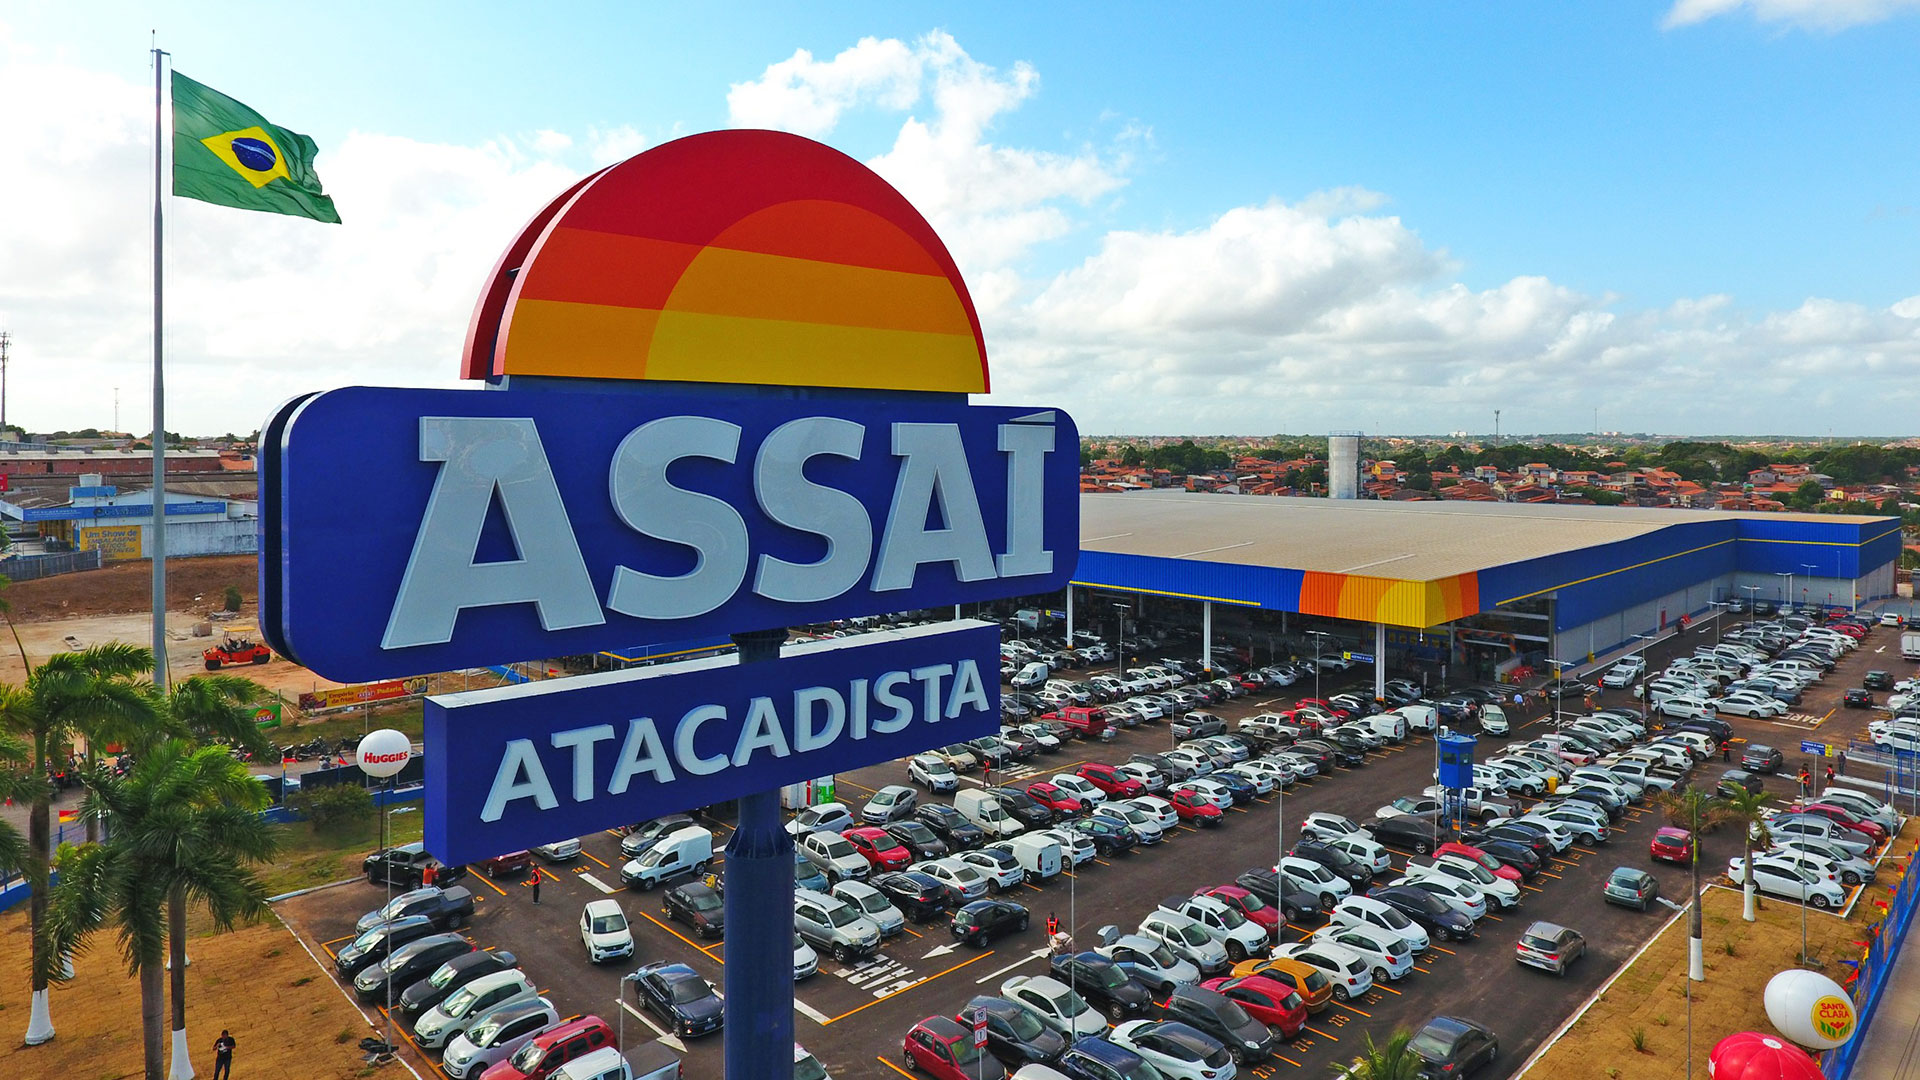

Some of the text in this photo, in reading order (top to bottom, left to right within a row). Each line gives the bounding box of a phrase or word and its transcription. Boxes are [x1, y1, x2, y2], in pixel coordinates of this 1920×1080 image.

[380, 411, 1055, 650] ASSAÍ
[479, 659, 990, 824] ATACADISTA
[363, 750, 409, 764] HUGGIES
[1820, 1002, 1846, 1010] SANTA
[1819, 1009, 1850, 1018] CLARA
